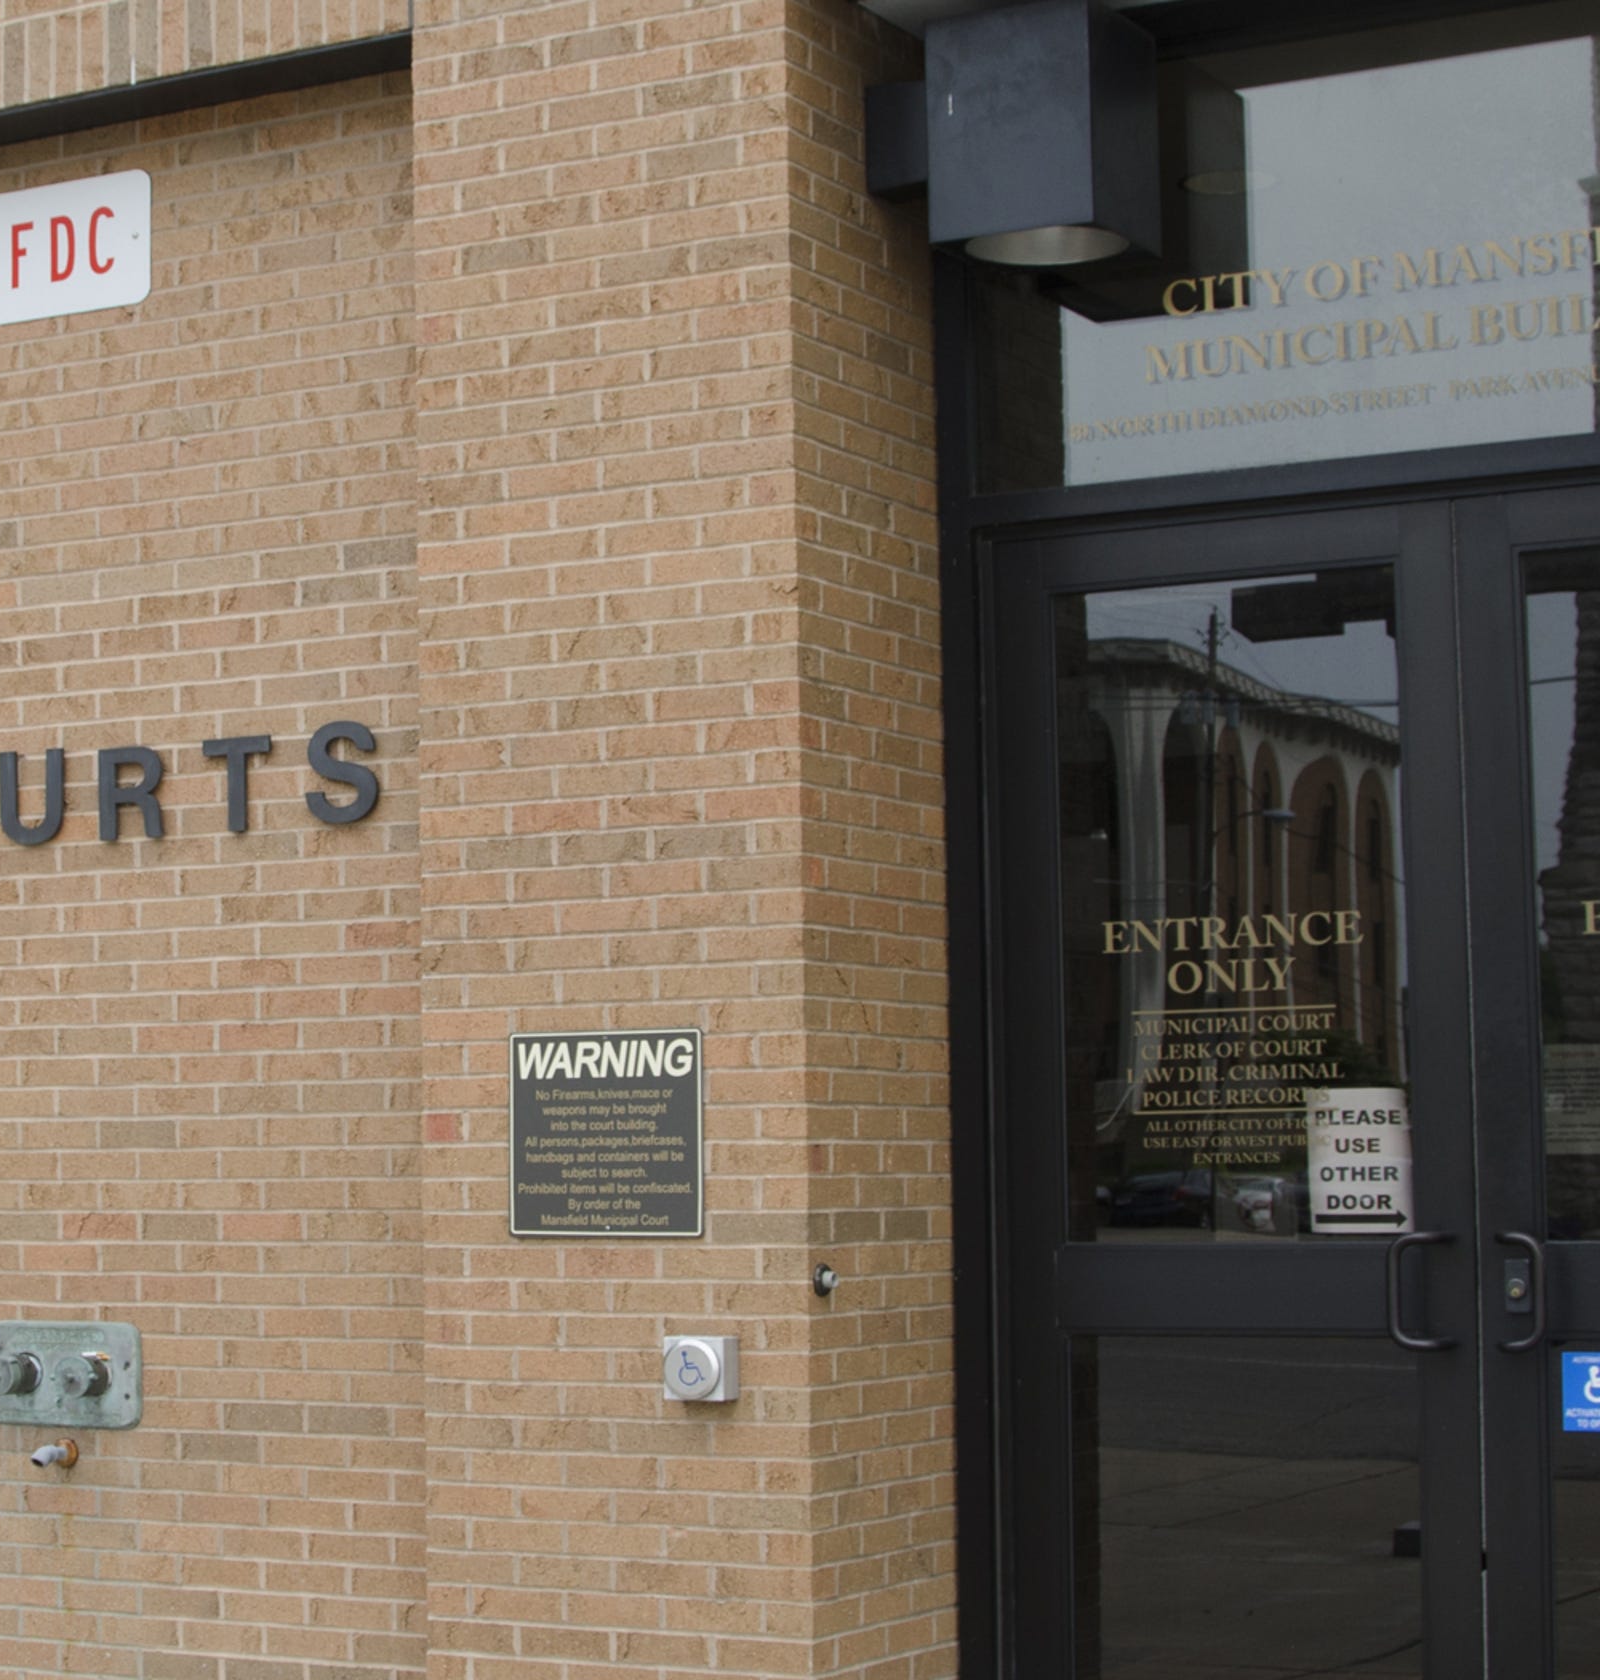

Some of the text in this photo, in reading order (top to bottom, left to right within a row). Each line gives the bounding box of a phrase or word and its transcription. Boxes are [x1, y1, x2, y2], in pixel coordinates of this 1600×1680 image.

[11, 206, 115, 289] FDC
[1162, 268, 1298, 317] CITY
[1305, 254, 1384, 303] OF
[1144, 310, 1458, 385] MUNICIPAL
[1095, 410, 1192, 439] NORTH
[1192, 395, 1328, 430] DIAMOND
[1329, 383, 1437, 416] STREET
[1448, 374, 1518, 401] PARK
[1102, 909, 1365, 954] ENTRANCE
[1167, 956, 1296, 994] ONLY
[1134, 1012, 1335, 1036] MUNICIPAL COURT
[1140, 1039, 1327, 1061] CLERK OF COURT
[518, 1038, 694, 1080] WARNING
[1126, 1062, 1345, 1084] LAW DIR. CRIMINAL
[535, 1089, 550, 1101] No
[662, 1089, 674, 1099] or
[1142, 1089, 1221, 1108] POLICE
[542, 1103, 667, 1117] weapons may be brought
[1314, 1109, 1401, 1126] PLEASE
[550, 1118, 658, 1132] into the court building.
[1146, 1116, 1330, 1133] ALL OTHER CITY OFFIC
[525, 1136, 538, 1147] All
[1143, 1134, 1331, 1149] USE EAST OR WEST PUBC
[1335, 1138, 1381, 1154] USE
[526, 1151, 684, 1165] handbags and containers will be
[1193, 1151, 1282, 1164] ENTRANCES
[561, 1167, 647, 1180] subject to search.
[1321, 1166, 1399, 1182] OTHER
[517, 1183, 693, 1194] Prohibited items will be confiscated.
[567, 1199, 641, 1212] By order of the
[1326, 1194, 1392, 1210] DOOR
[540, 1214, 669, 1228] Mansfield Municipal Court
